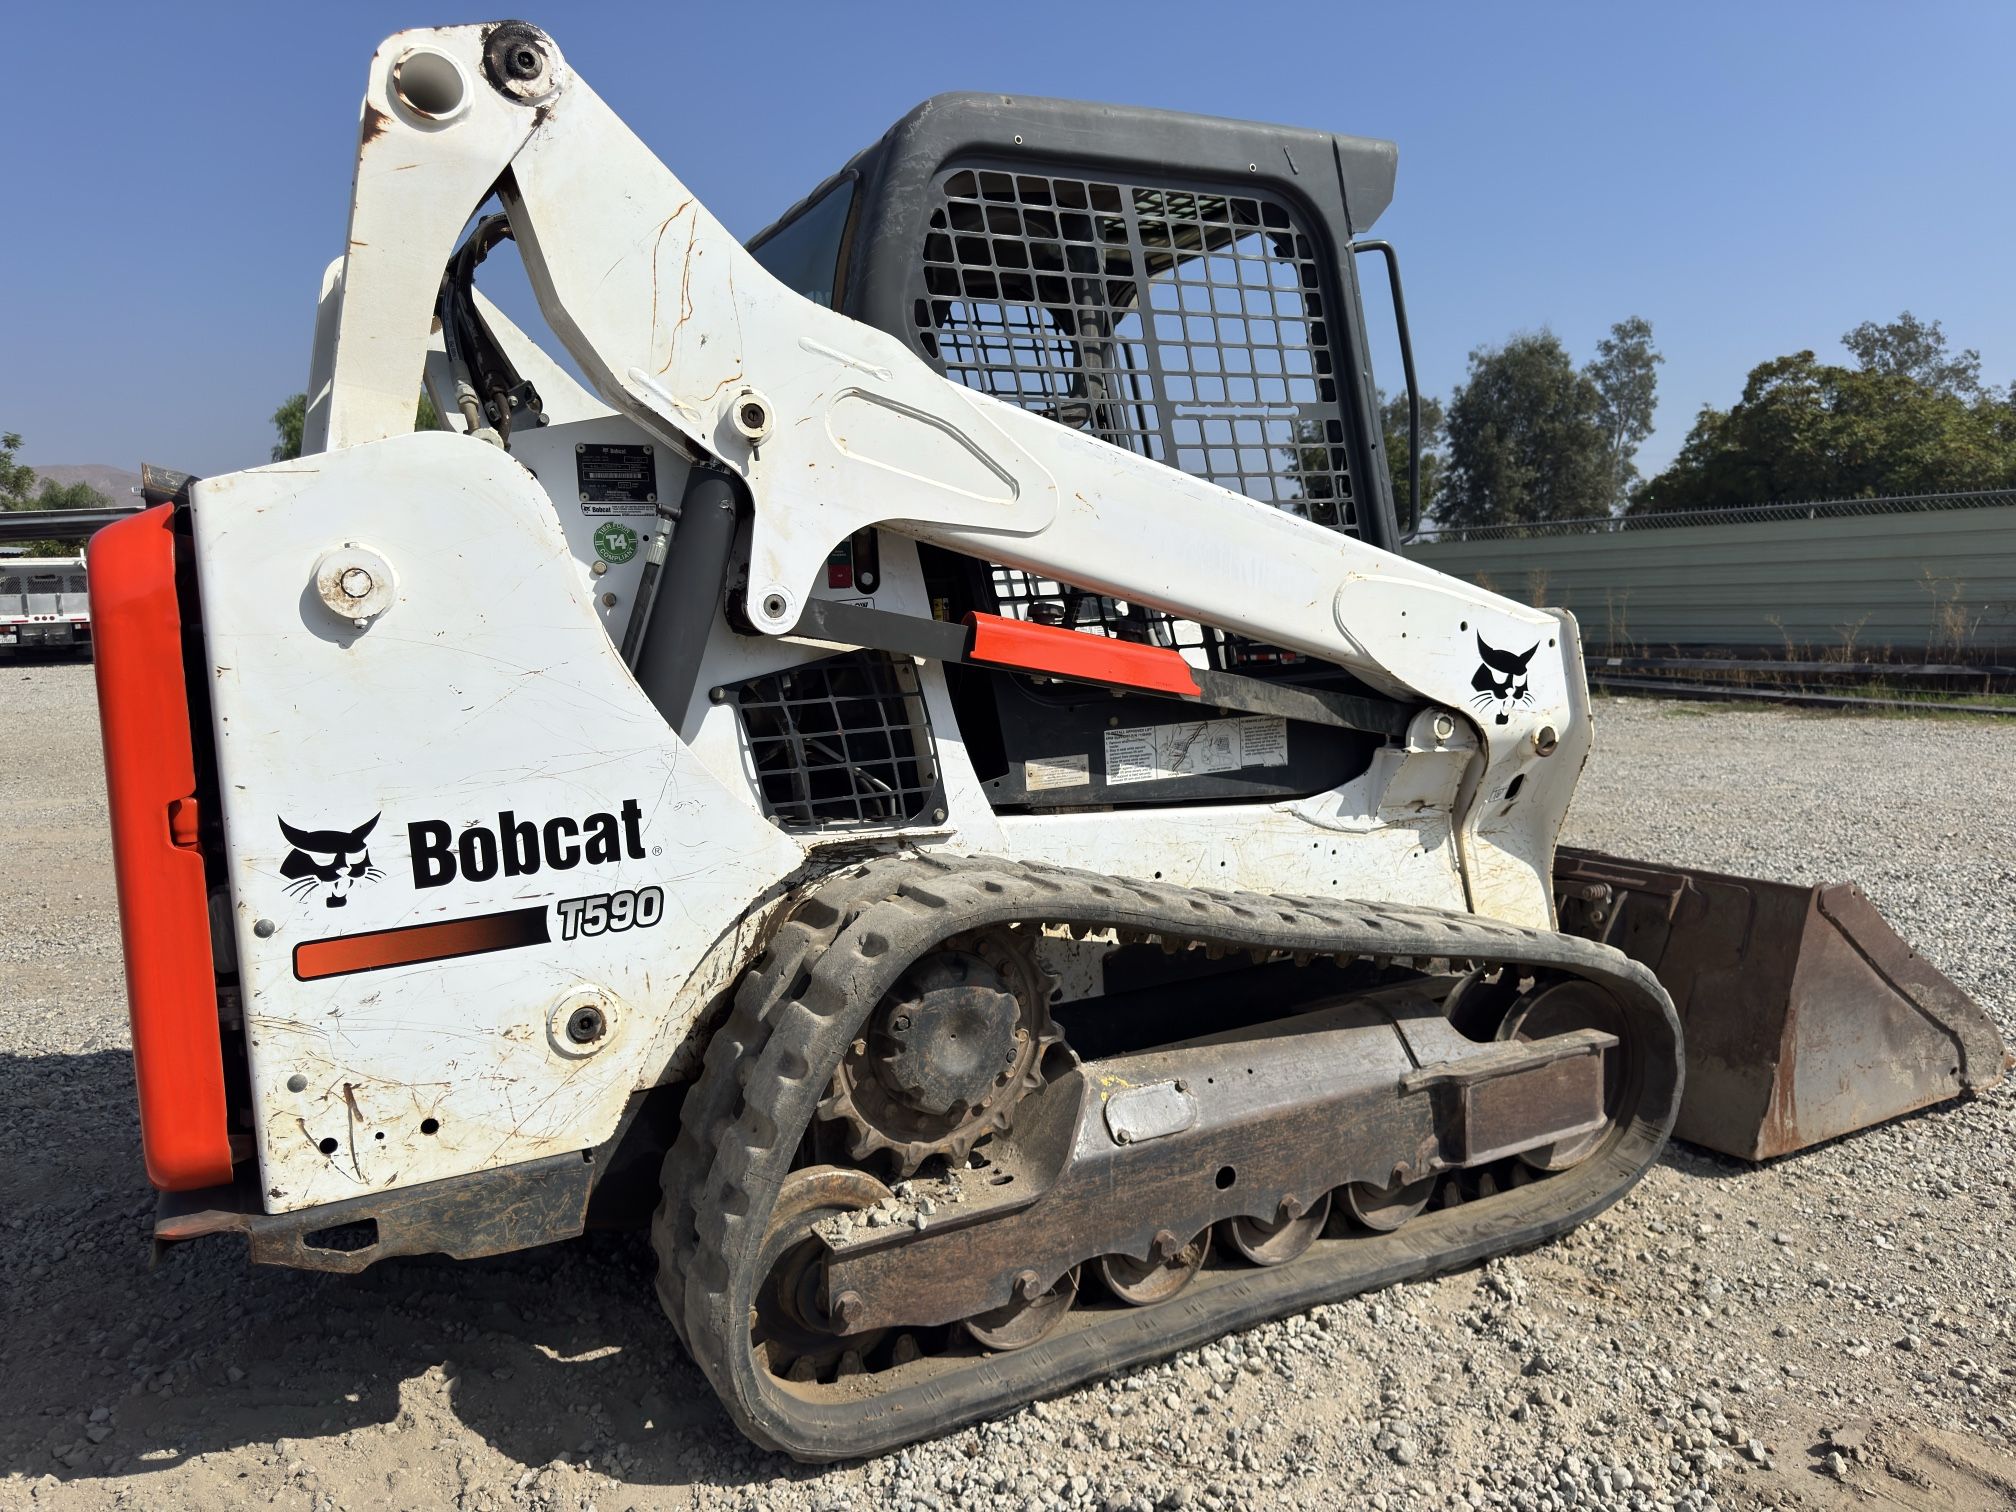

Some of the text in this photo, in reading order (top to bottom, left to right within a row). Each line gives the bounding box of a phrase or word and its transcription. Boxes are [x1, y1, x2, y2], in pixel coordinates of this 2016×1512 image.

[598, 523, 631, 535] TIER FOUR
[606, 534, 627, 550] T4
[600, 547, 635, 561] COMPLIANT
[408, 799, 646, 889] Bobcat
[557, 886, 664, 941] T590
